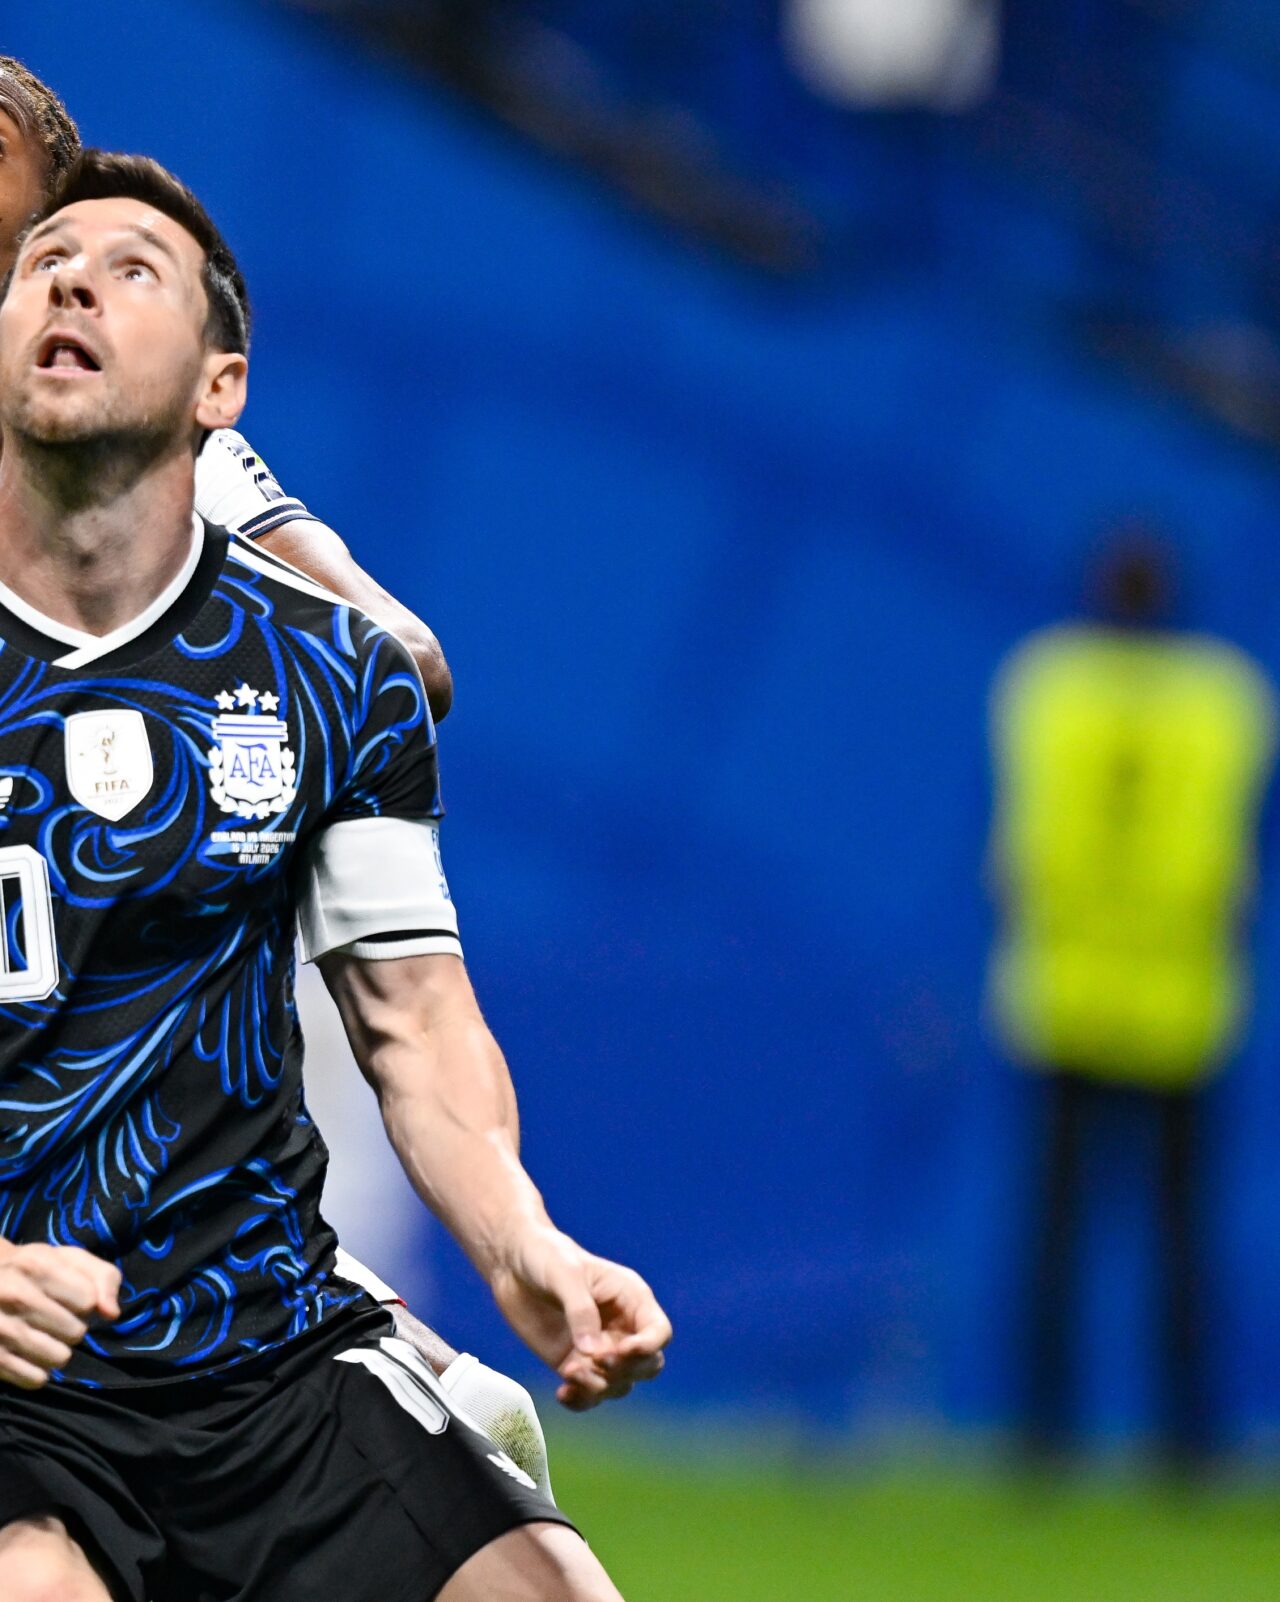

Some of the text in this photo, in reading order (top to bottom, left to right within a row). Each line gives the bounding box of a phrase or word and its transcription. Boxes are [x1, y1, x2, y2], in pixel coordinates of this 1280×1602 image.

[229, 741, 277, 787] AFA
[95, 779, 129, 793] FIFA
[241, 842, 259, 853] JULY
[260, 842, 279, 853] 2026
